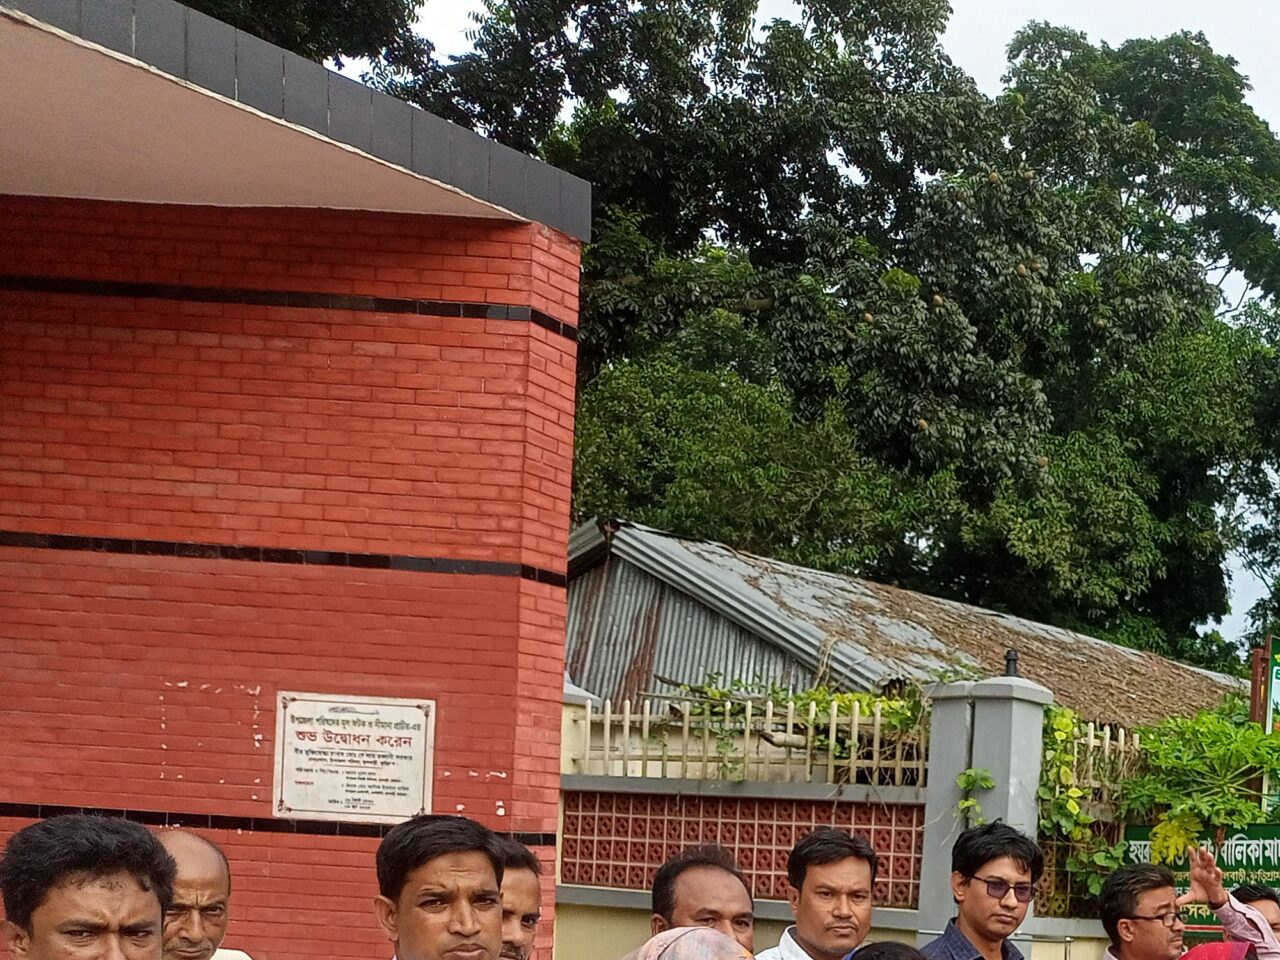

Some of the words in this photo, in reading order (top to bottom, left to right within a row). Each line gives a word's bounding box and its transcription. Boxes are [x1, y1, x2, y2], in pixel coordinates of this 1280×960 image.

[295, 729, 318, 742] শুভ
[322, 728, 371, 745] উদ্বোধন
[376, 734, 412, 748] করেন
[1221, 834, 1263, 867] বালিকা
